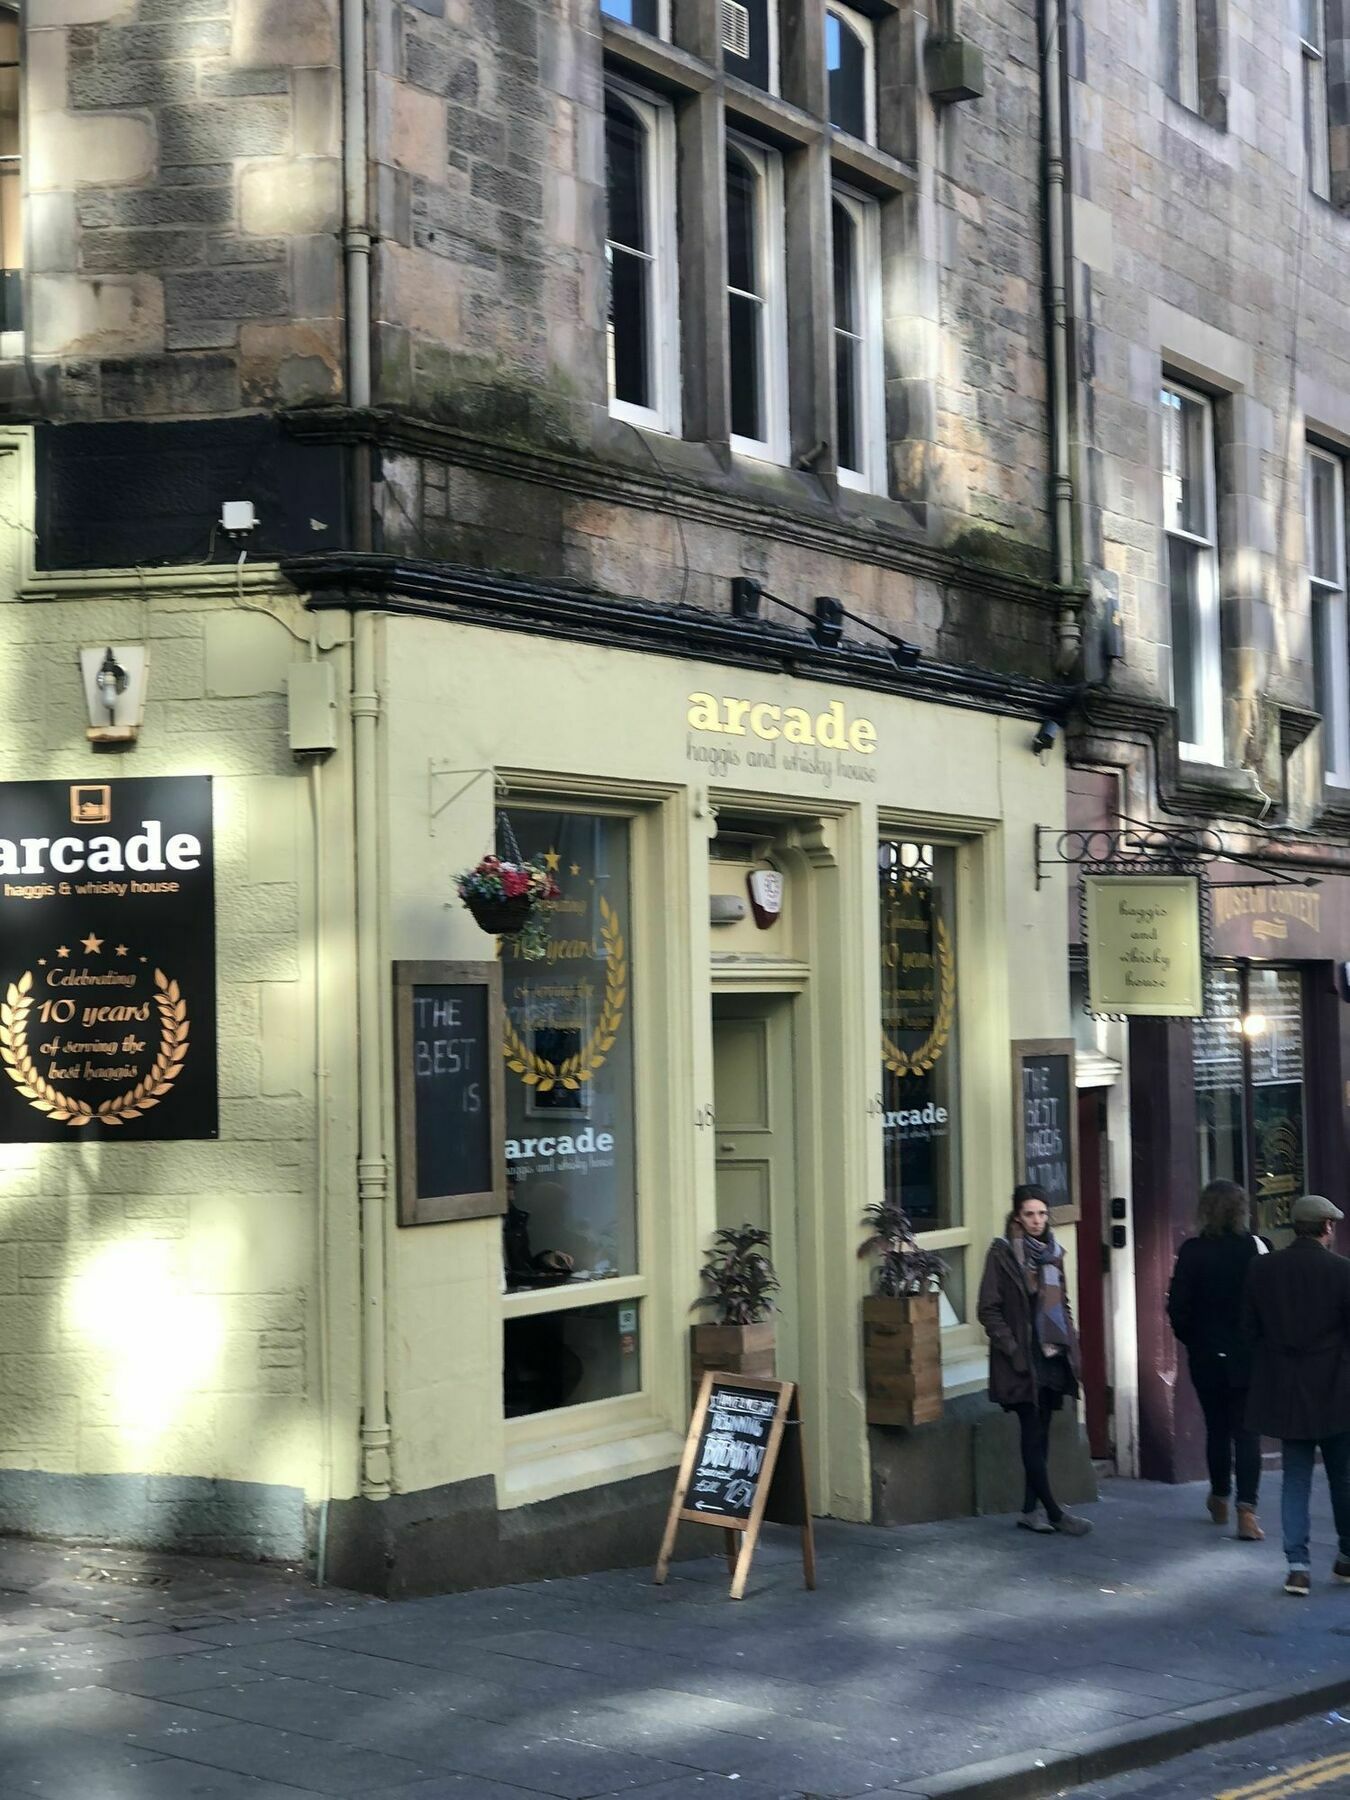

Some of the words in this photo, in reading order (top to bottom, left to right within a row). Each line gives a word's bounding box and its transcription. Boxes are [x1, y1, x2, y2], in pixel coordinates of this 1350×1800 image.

[687, 691, 878, 754] arcade
[686, 731, 740, 777] haggis
[746, 742, 776, 769] and
[782, 742, 832, 788] whisky
[836, 751, 876, 783] house
[0, 820, 201, 875] arcade
[4, 882, 56, 899] haggis
[58, 881, 71, 896] &
[75, 880, 127, 896] whisky
[130, 879, 180, 893] house
[1119, 900, 1168, 924] haggis
[1130, 927, 1157, 940] and
[1119, 947, 1170, 972] whisky
[46, 968, 137, 988] Celebrating
[1125, 970, 1167, 987] house
[37, 999, 76, 1023] 10
[82, 1002, 150, 1028] years
[415, 998, 462, 1029] THE
[40, 1035, 61, 1056] of
[62, 1039, 118, 1056] serving
[121, 1034, 146, 1054] the
[416, 1038, 476, 1076] BEST
[48, 1061, 81, 1079] best
[83, 1061, 138, 1081] haggis
[462, 1082, 481, 1112] IS
[504, 1127, 614, 1159] arcade
